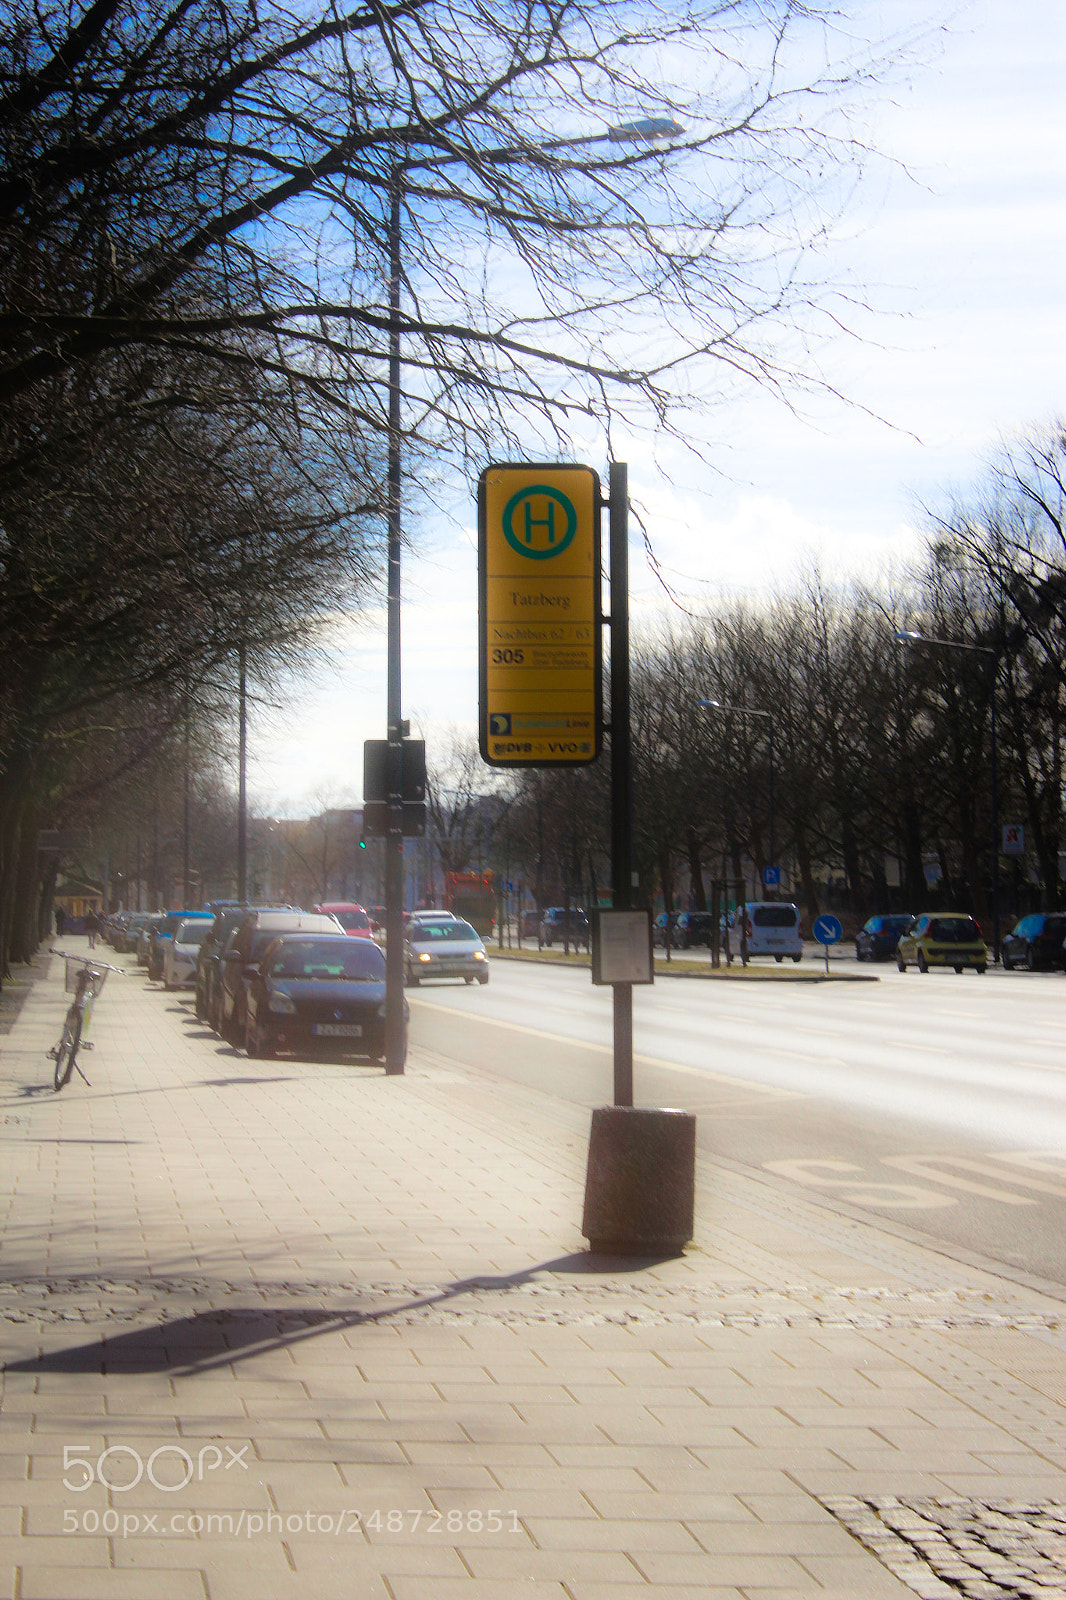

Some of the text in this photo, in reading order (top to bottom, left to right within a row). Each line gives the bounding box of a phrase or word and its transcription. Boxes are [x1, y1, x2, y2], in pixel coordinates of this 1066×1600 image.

[524, 501, 554, 543] H
[491, 648, 525, 664] 305
[548, 742, 578, 753] VVO
